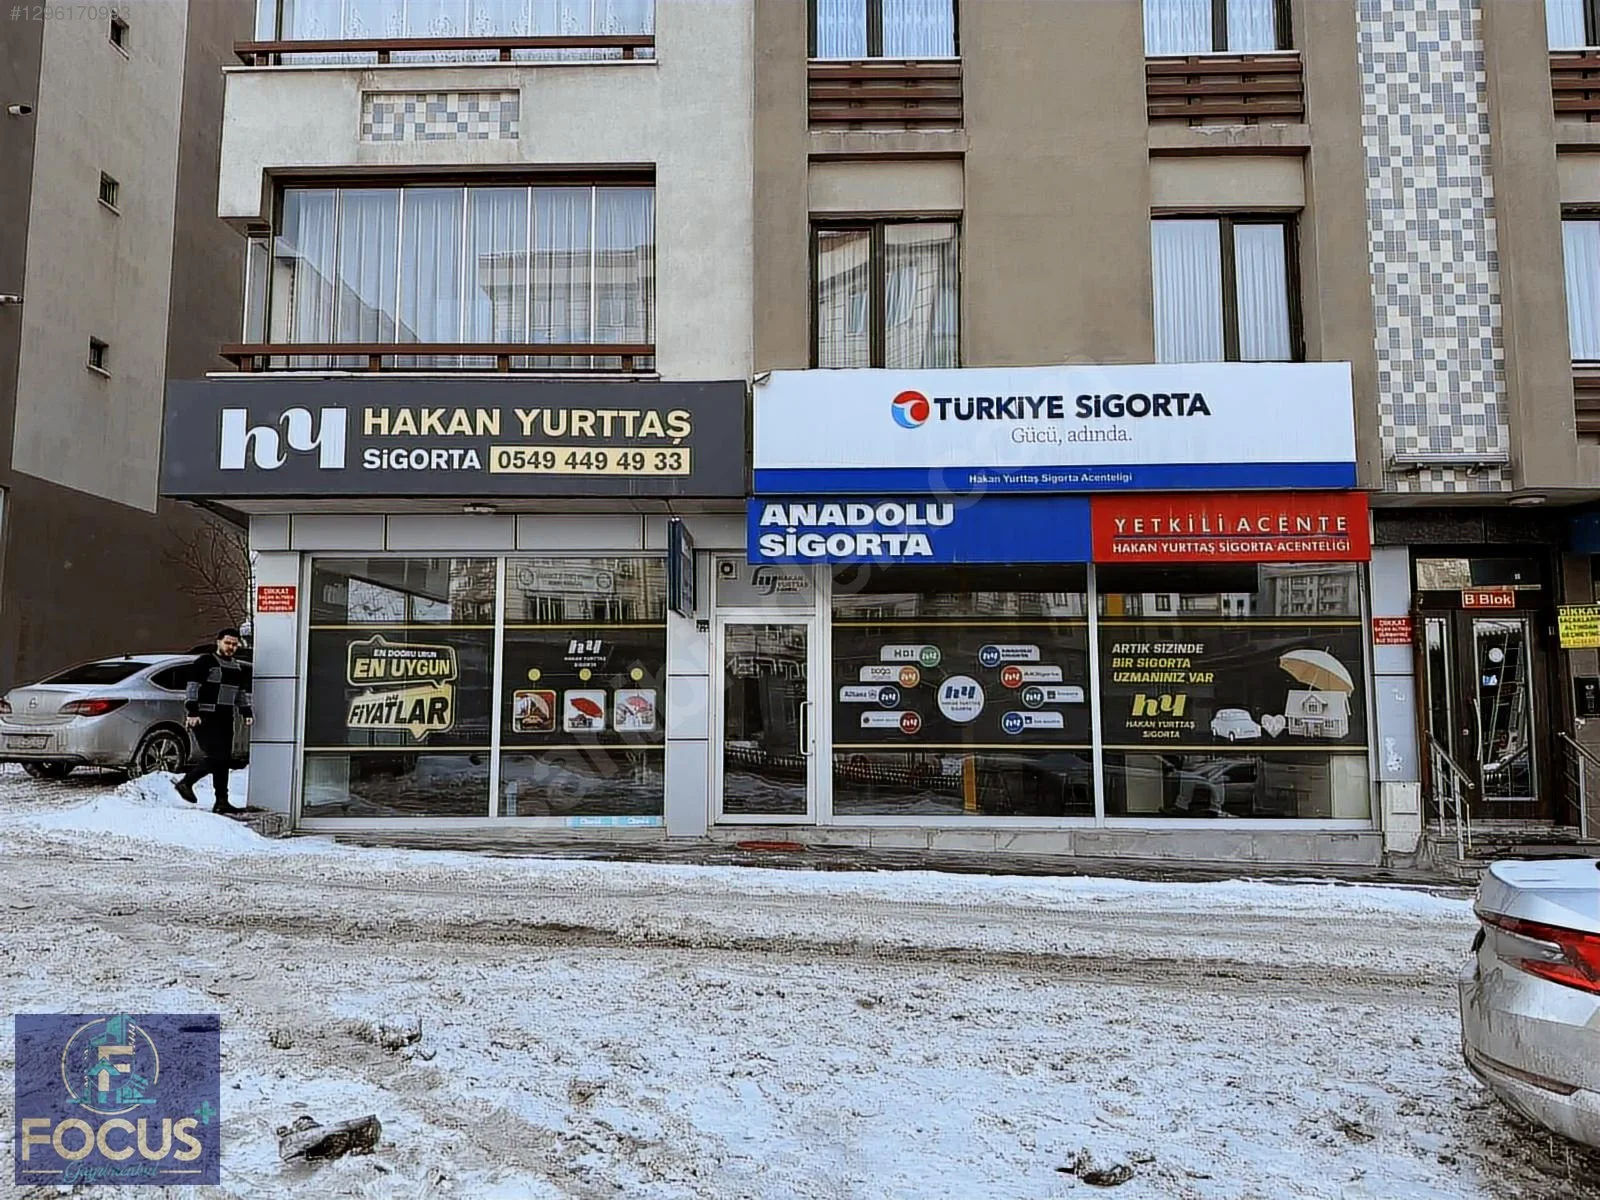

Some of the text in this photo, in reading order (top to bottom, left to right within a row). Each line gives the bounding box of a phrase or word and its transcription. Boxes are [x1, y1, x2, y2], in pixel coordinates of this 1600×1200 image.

[363, 408, 691, 446] HAKAN YURTTAŞ
[1011, 425, 1132, 446] Gücü, adında.
[498, 450, 556, 470] 0549
[564, 450, 608, 471] 449
[616, 451, 645, 471] 49
[654, 452, 682, 471] 33
[968, 474, 1000, 484] Hakan
[759, 502, 954, 526] ANADOLU
[1236, 514, 1348, 533] ACENTE
[1112, 540, 1157, 553] HAKAN
[1161, 539, 1215, 554] YURTTAŞ
[1464, 594, 1512, 605] B Blok
[1111, 643, 1151, 654] ARTIK
[354, 658, 450, 678] EN UYGUN
[1188, 672, 1215, 683] VAR
